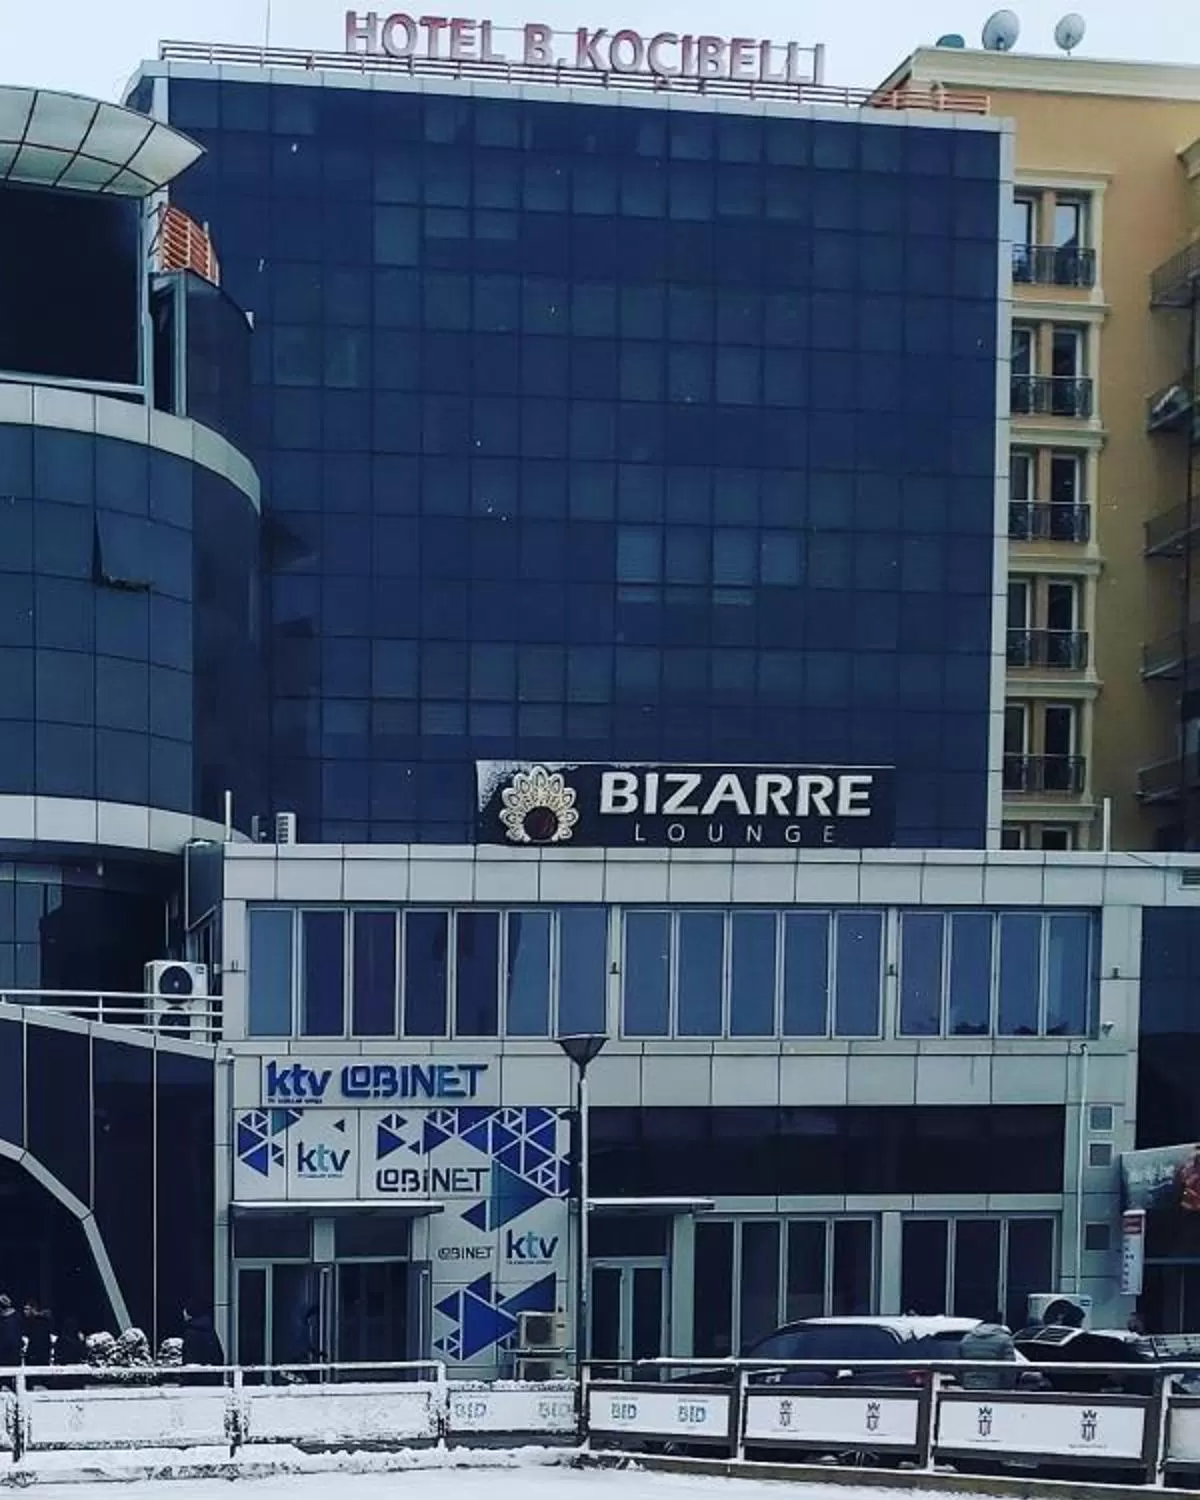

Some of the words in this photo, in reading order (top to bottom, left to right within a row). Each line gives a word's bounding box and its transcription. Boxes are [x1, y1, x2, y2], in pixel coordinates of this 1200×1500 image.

[346, 11, 505, 63] HOTEL
[600, 772, 873, 816] BIZARRE
[634, 823, 836, 844] LOUNGE
[266, 1060, 332, 1097] ktv
[297, 1141, 351, 1173] ktv
[506, 1229, 559, 1259] ktv
